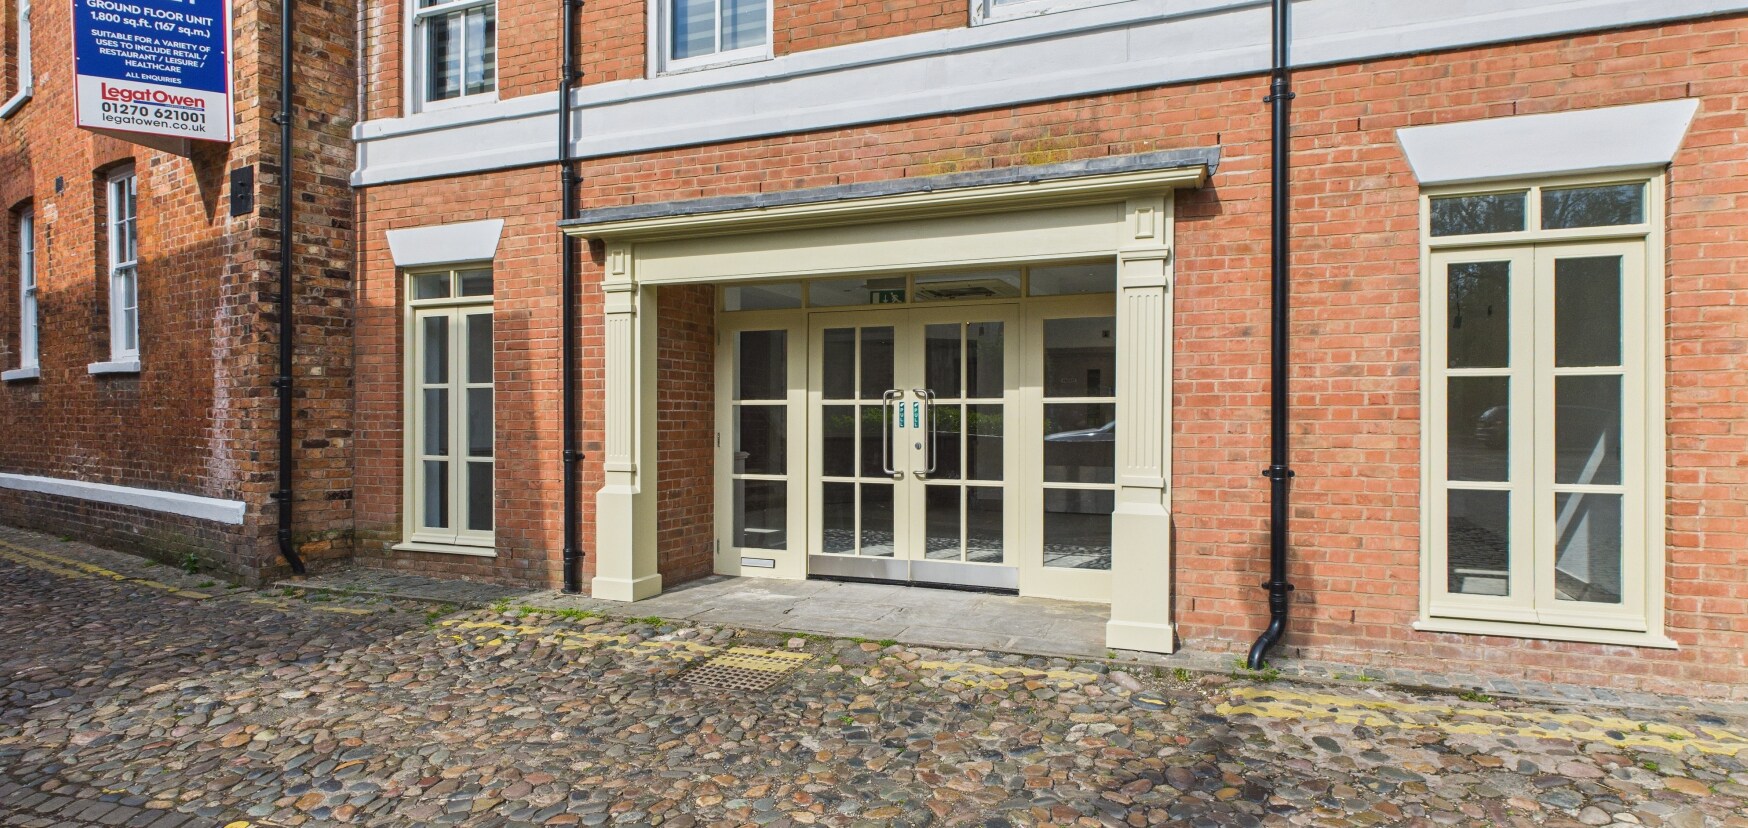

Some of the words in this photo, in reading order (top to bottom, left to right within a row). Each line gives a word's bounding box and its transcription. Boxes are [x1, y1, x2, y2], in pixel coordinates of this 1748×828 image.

[87, 0, 141, 15] GROUND
[144, 7, 184, 22] FLOOR
[186, 14, 213, 26] UNIT
[123, 17, 152, 28] sq.ft.
[155, 20, 175, 31] (167
[178, 26, 210, 38] sq.m.)
[91, 29, 132, 41] SUITABLE
[134, 35, 152, 44] FOR
[162, 40, 197, 51] VARIETY
[199, 45, 211, 53] OF
[96, 38, 118, 47] USES
[120, 41, 133, 50] TO
[135, 44, 171, 55] INCLUDE
[173, 49, 201, 60] RETAIL
[99, 47, 156, 62] RESTAURANT
[165, 56, 198, 68] LEISURE
[125, 59, 181, 73] HEALTHCARE
[125, 71, 140, 79] ALL
[142, 73, 182, 84] ENQUIRIES
[102, 102, 149, 117] 01270
[154, 109, 205, 123] 621001
[103, 113, 206, 132] legatowen.co.uk
